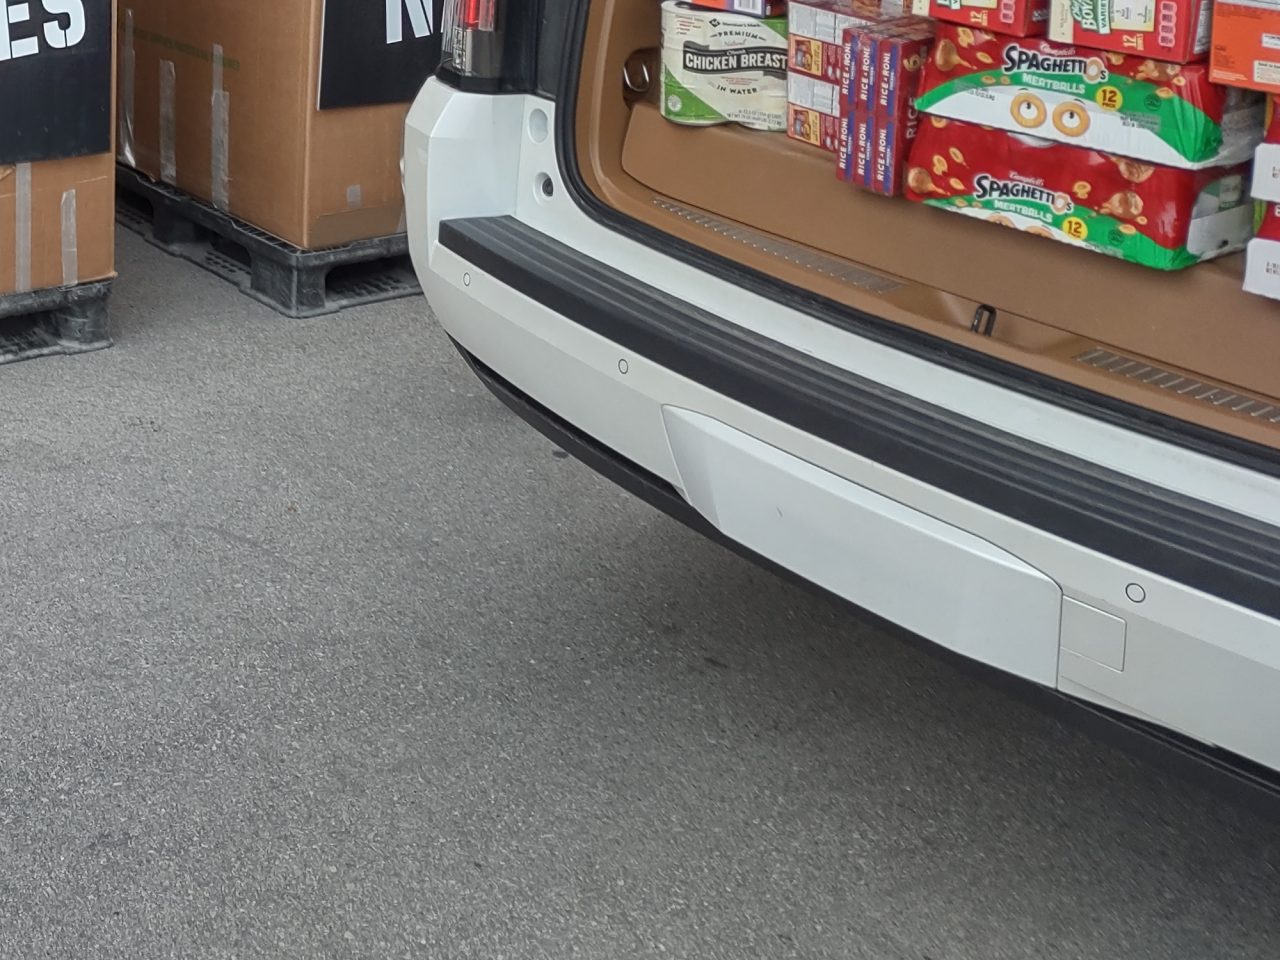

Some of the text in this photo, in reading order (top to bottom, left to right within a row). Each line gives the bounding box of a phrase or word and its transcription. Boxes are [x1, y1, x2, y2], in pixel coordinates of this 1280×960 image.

[718, 30, 758, 39] PREMIUM
[685, 53, 787, 70] CHICKEN BREAST
[882, 53, 890, 77] RONI
[903, 54, 920, 71] 6
[860, 77, 868, 100] RICE
[1022, 72, 1086, 94] MEATBALLS
[880, 82, 888, 106] RICE
[1101, 88, 1118, 103] 12
[994, 199, 1053, 223] MEATBALLS
[1067, 220, 1083, 234] 12
